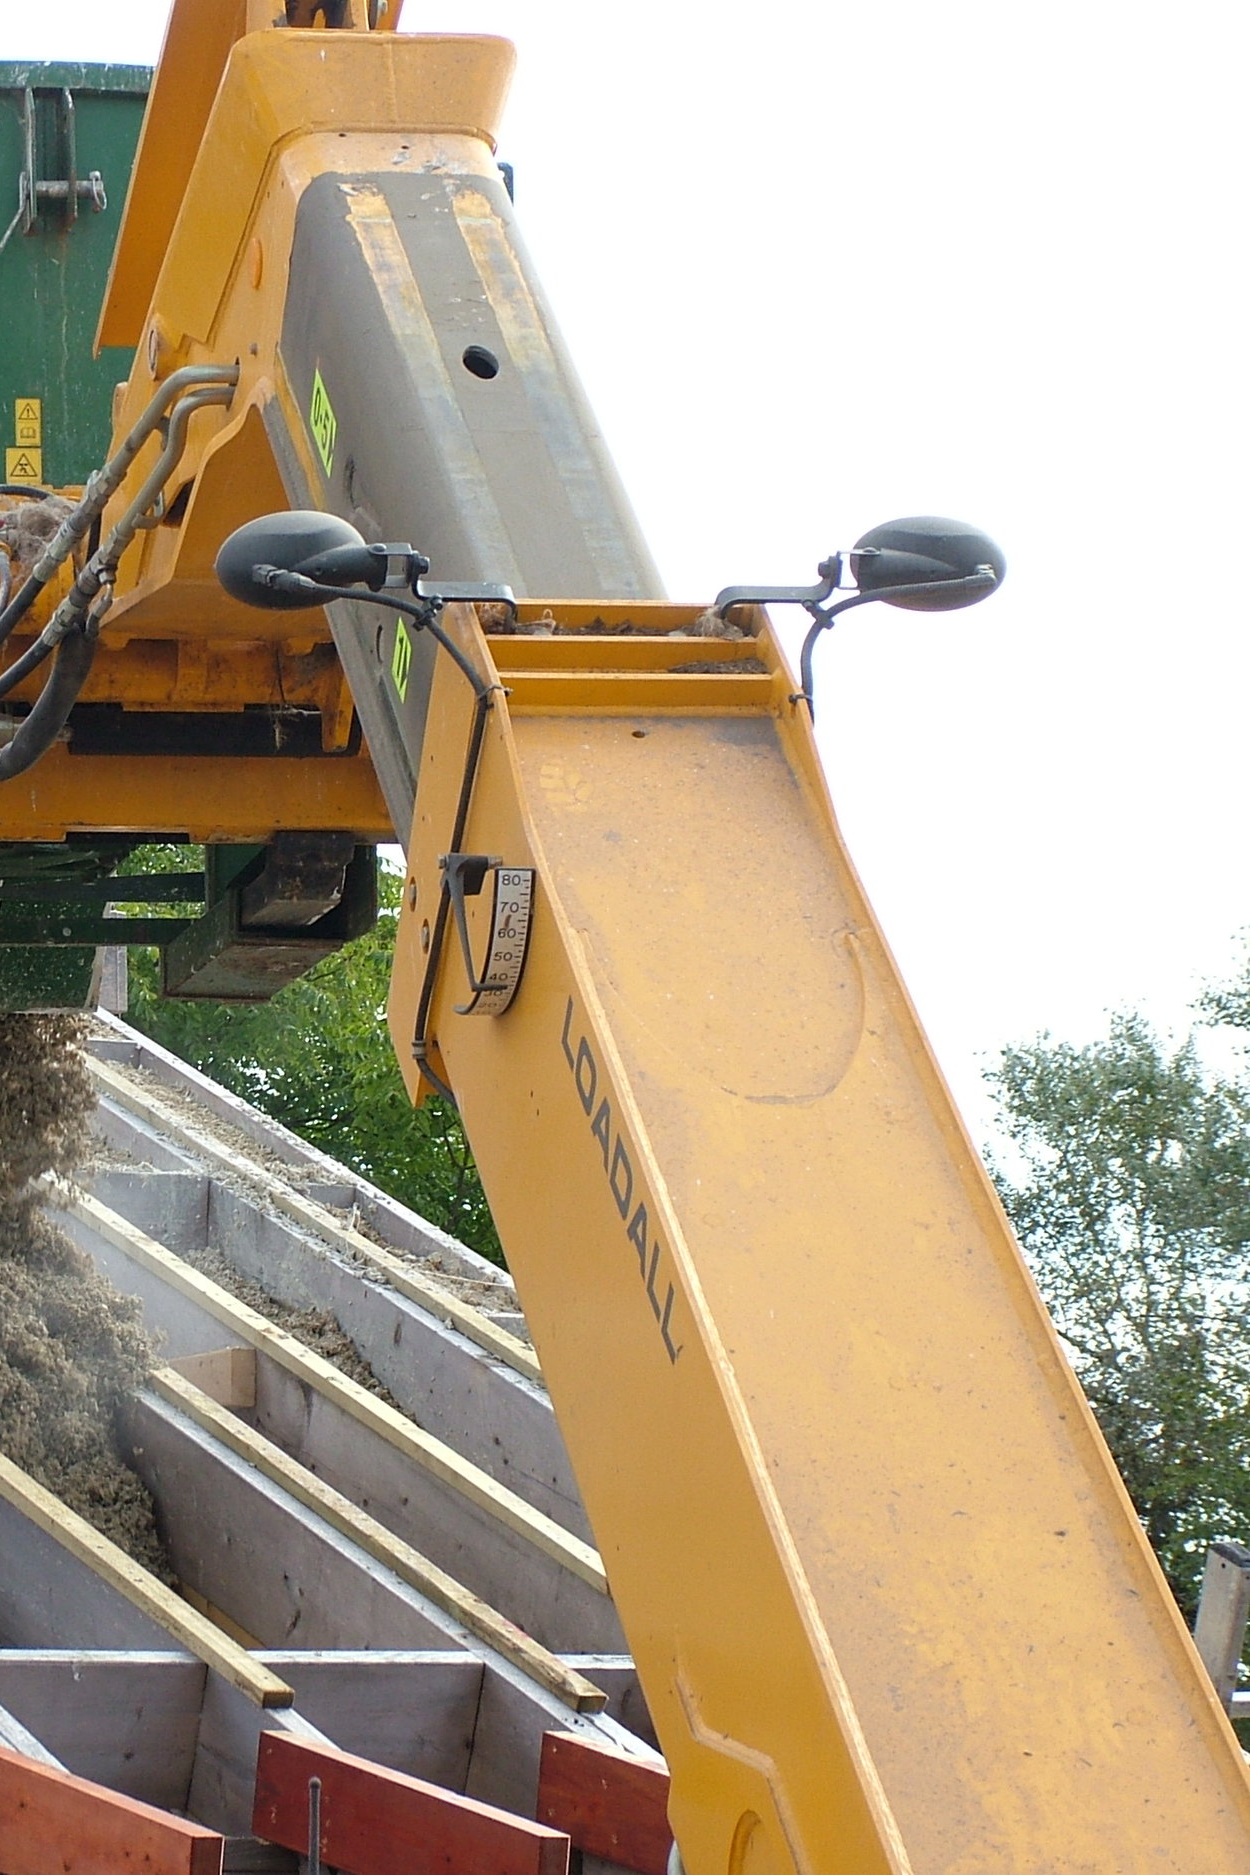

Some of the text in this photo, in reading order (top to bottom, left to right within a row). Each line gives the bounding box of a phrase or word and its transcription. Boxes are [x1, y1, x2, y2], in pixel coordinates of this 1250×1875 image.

[501, 874, 521, 886] 80
[500, 901, 520, 913] 70
[498, 928, 516, 939] 60
[493, 951, 513, 962] 50
[489, 973, 508, 981] 40
[561, 994, 684, 1366] LOADALL
